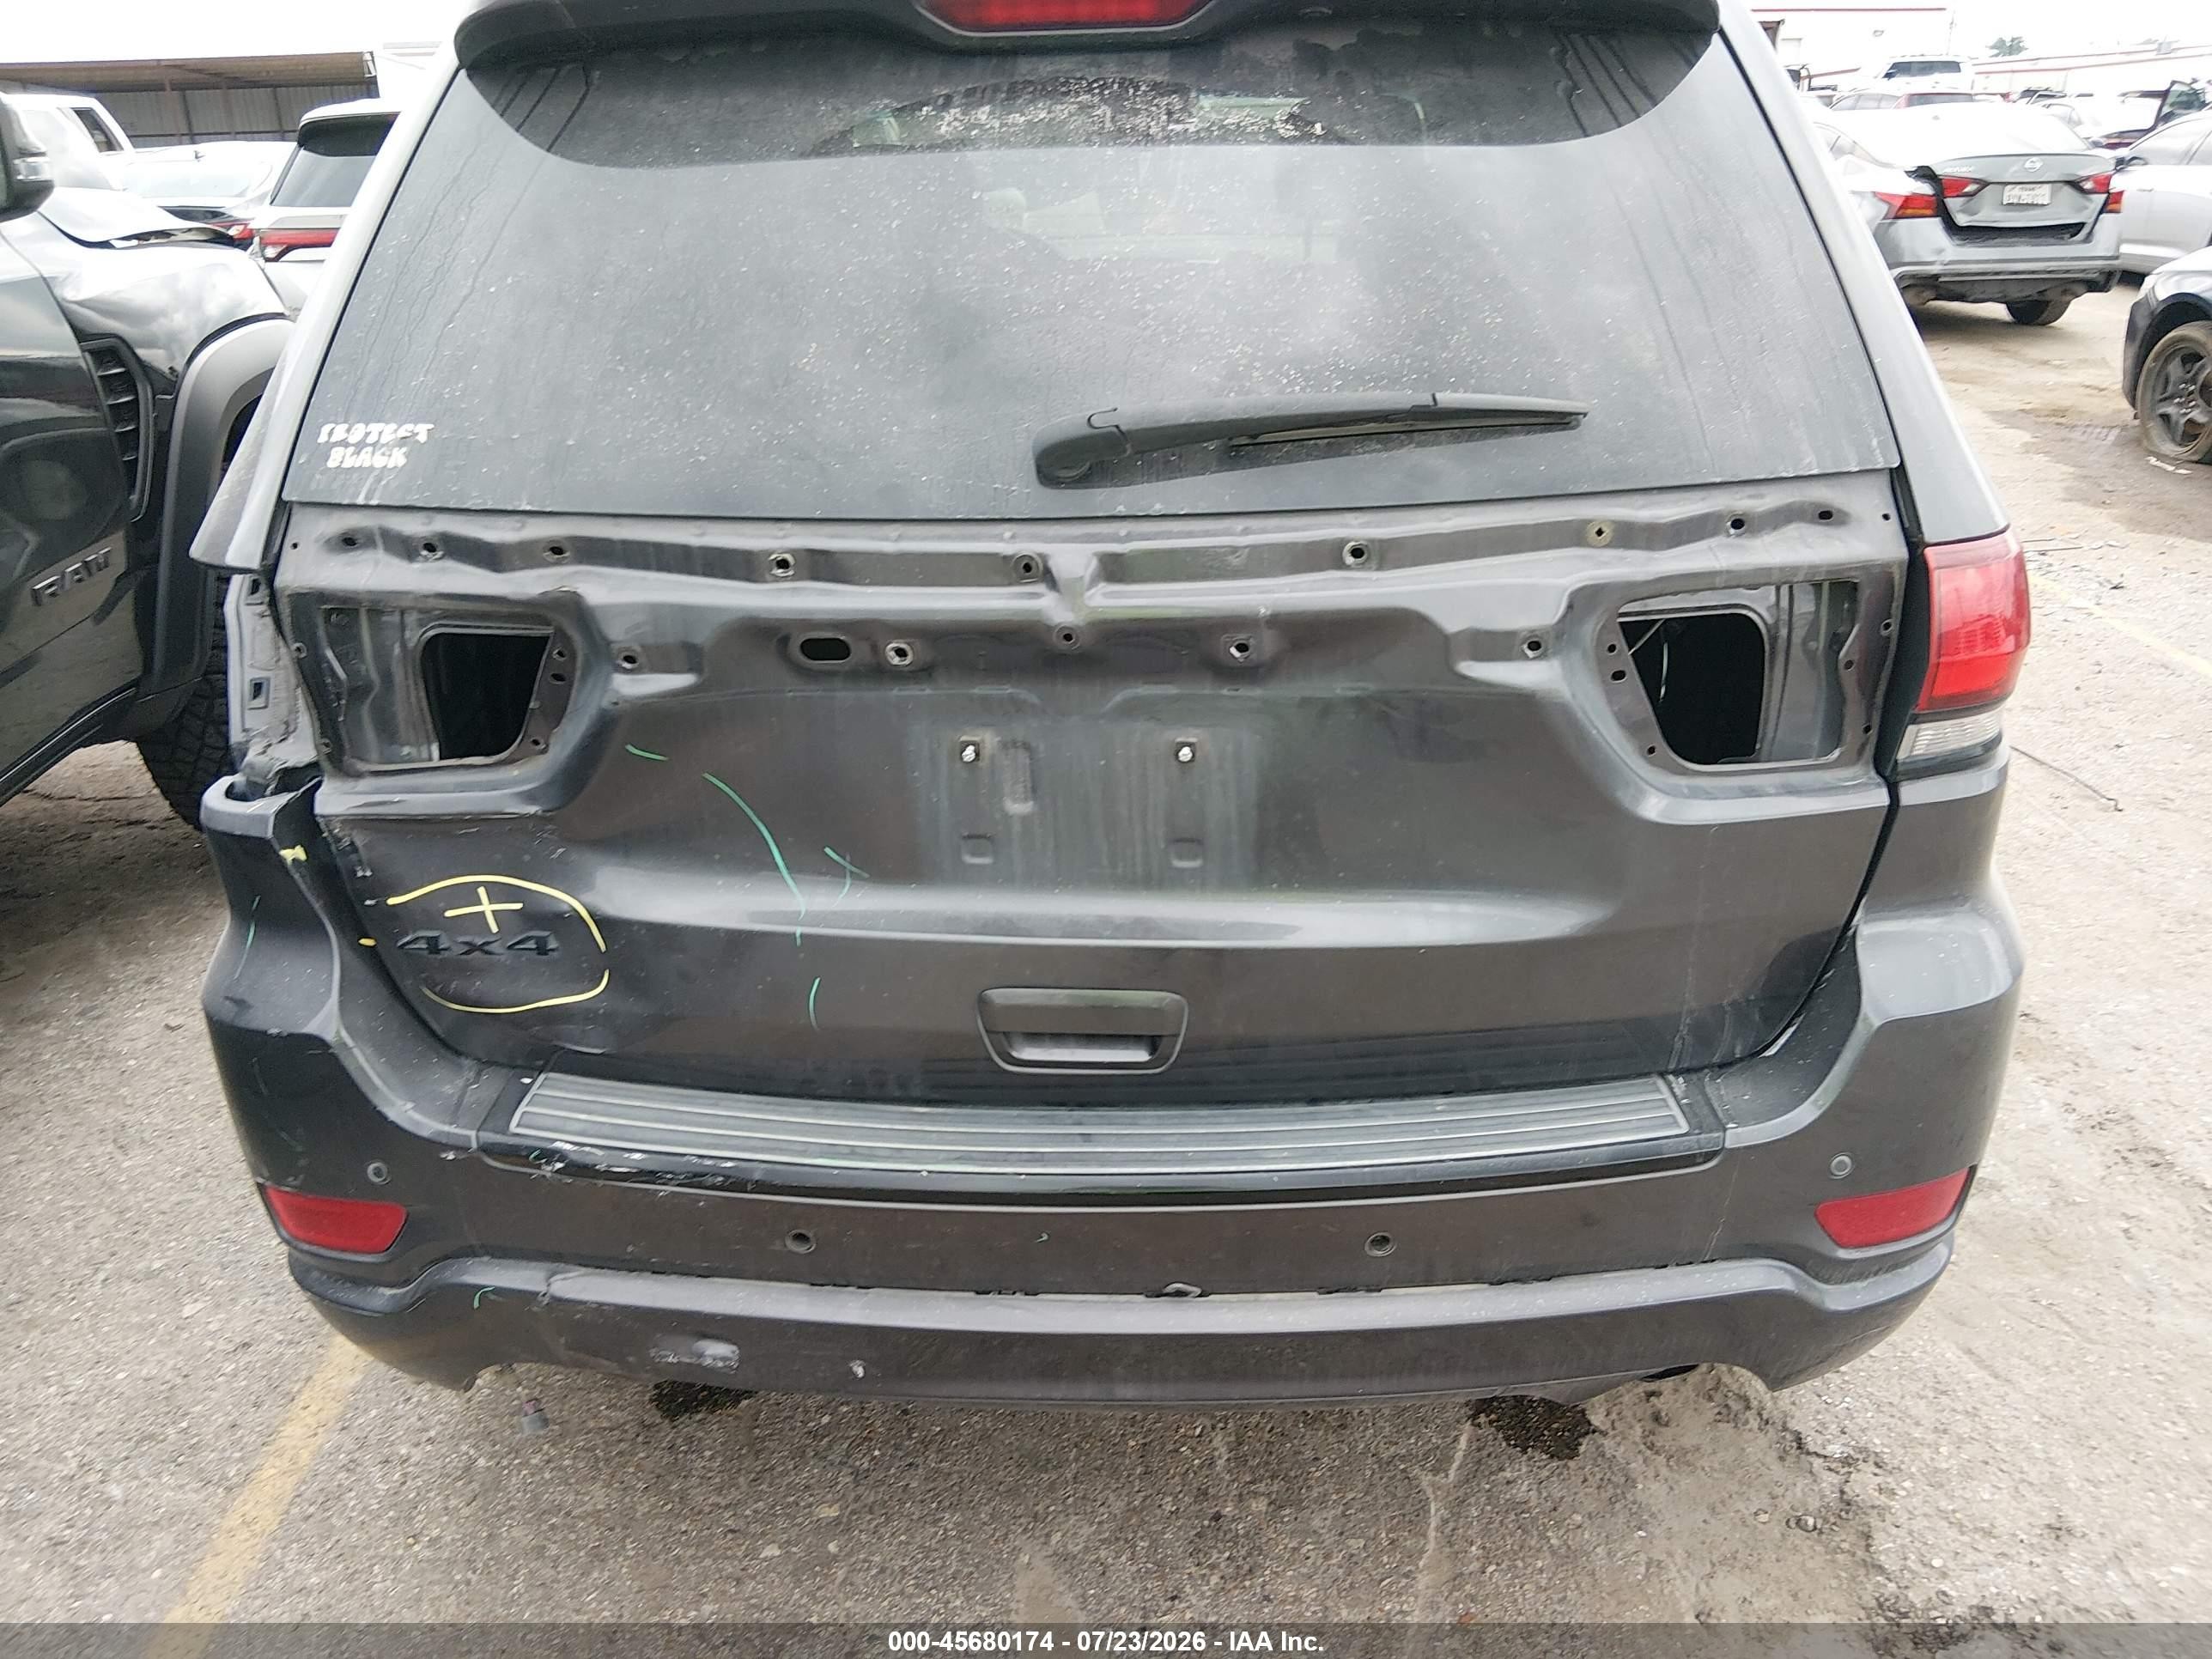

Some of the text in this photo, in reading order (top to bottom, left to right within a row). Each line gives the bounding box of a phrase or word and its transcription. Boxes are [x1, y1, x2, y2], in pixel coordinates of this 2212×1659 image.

[326, 446, 408, 468] BLACK
[31, 546, 112, 606] RAM
[396, 930, 559, 956] 4x4
